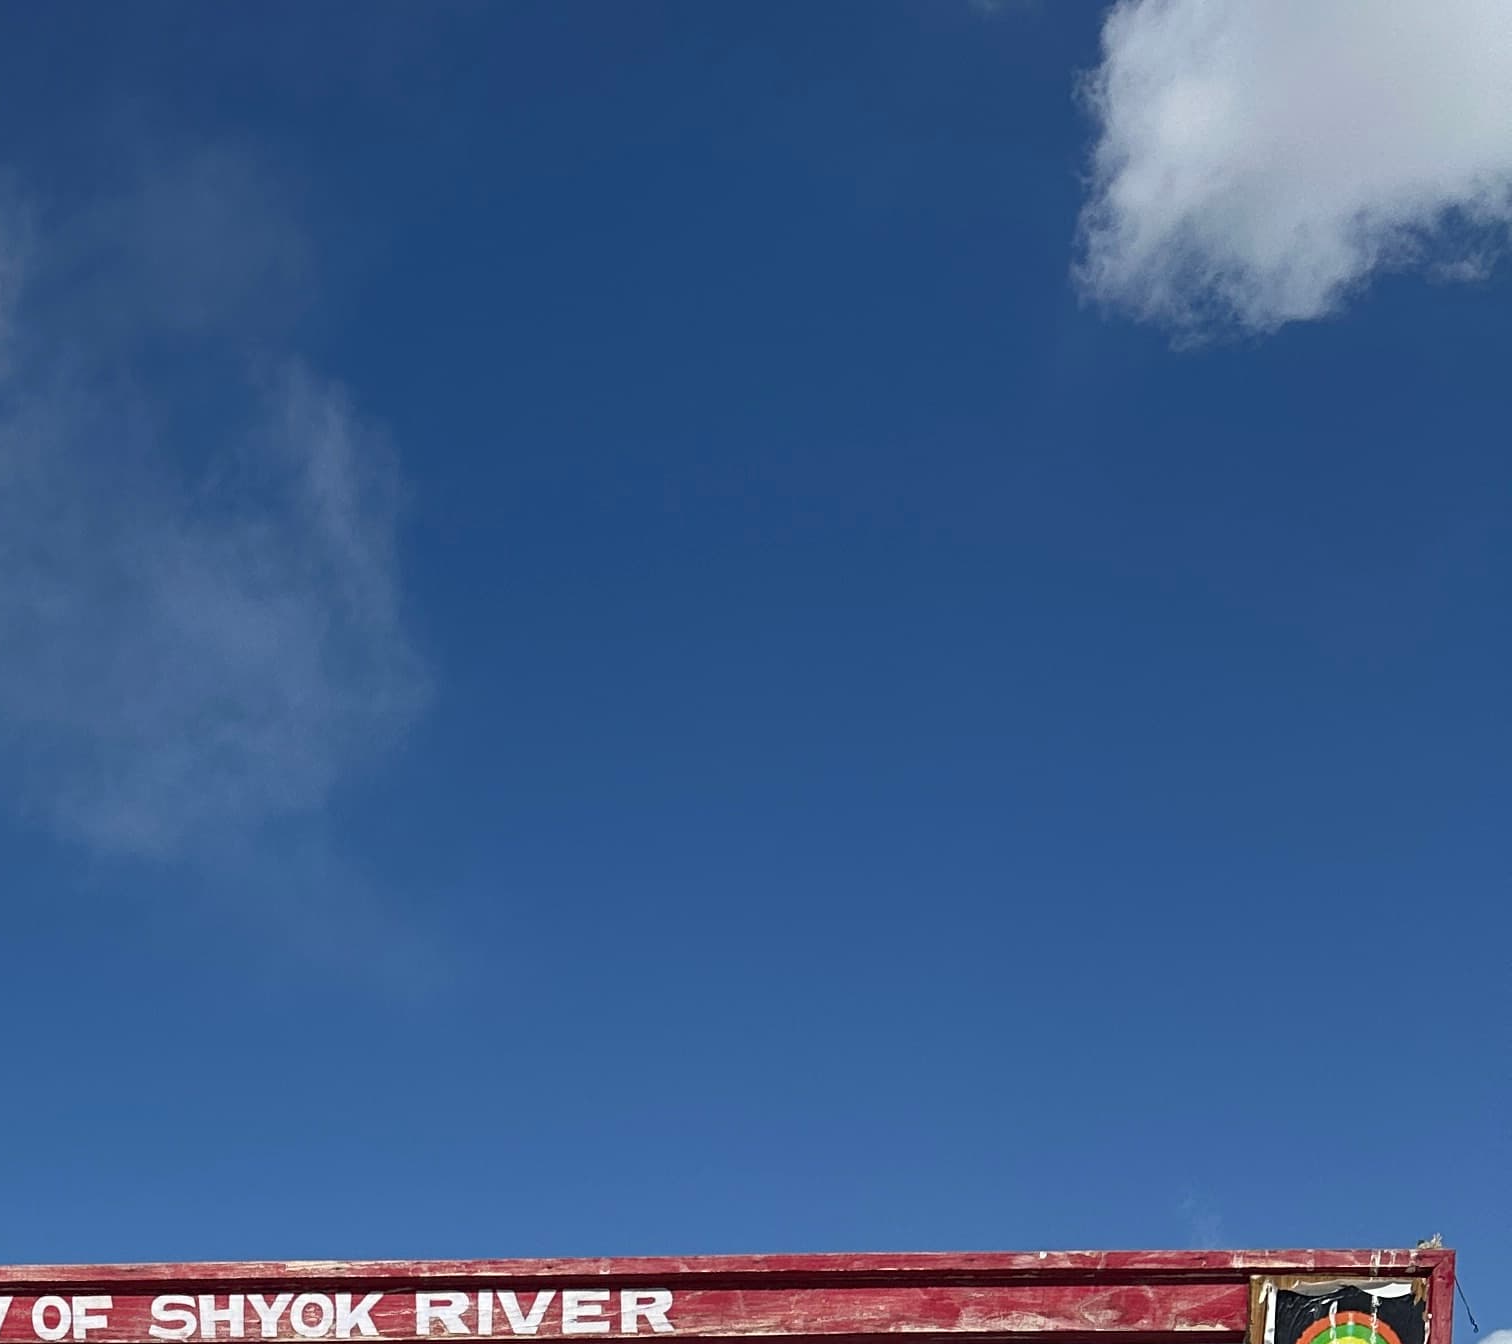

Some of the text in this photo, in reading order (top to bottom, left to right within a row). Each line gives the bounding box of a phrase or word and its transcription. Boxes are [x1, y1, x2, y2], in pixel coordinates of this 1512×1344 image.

[31, 1295, 113, 1342] OF
[148, 1293, 383, 1338] SHYOK
[414, 1288, 675, 1336] RIVER
